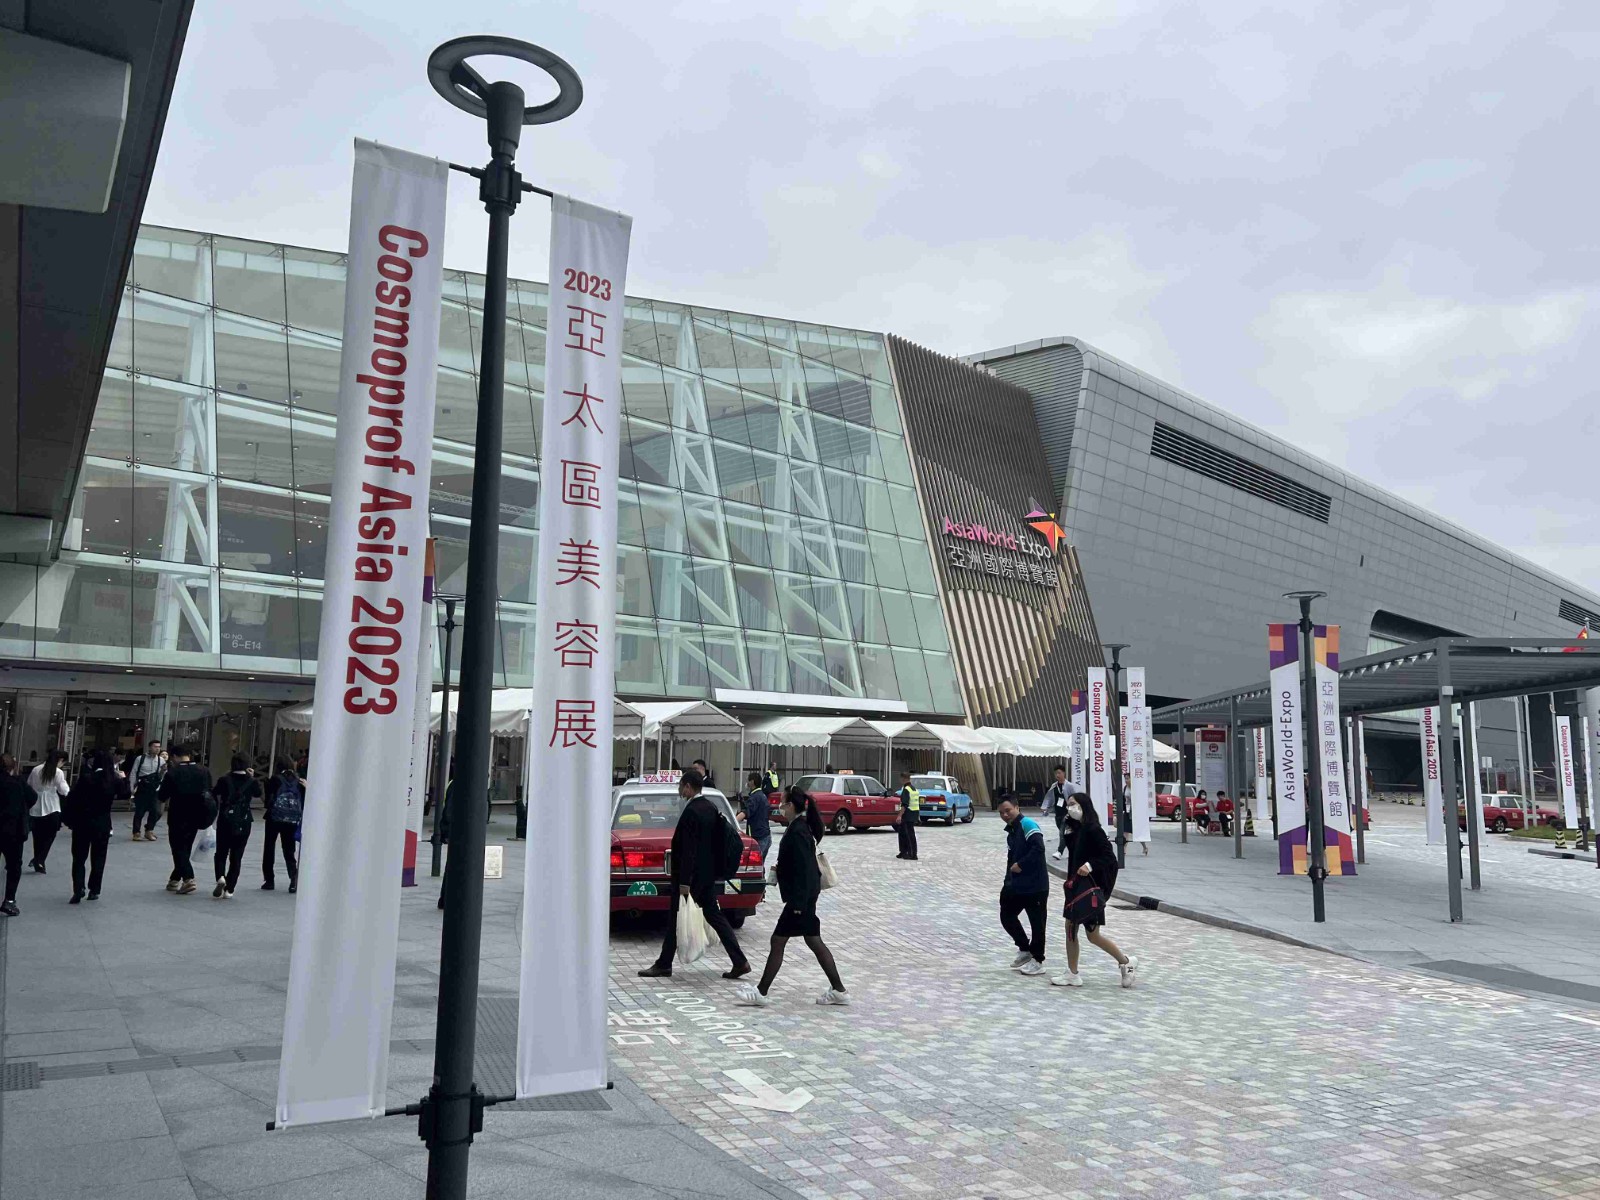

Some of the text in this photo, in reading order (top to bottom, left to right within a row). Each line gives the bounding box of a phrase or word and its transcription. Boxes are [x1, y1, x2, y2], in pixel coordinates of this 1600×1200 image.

[563, 267, 612, 301] 2023
[343, 224, 429, 715] Cosmoprof Asia 2023
[549, 304, 607, 748] 亞太區美容展
[944, 515, 1051, 561] AsiaWorld-Expo
[1091, 681, 1105, 773] Cosmoprof Asia 2023
[1279, 691, 1296, 801] AsiaWorld-Expo
[1422, 707, 1438, 780] moprof Asia 2023
[1564, 772, 1573, 787] 2023
[655, 991, 796, 1059] LOOK RIGHT
